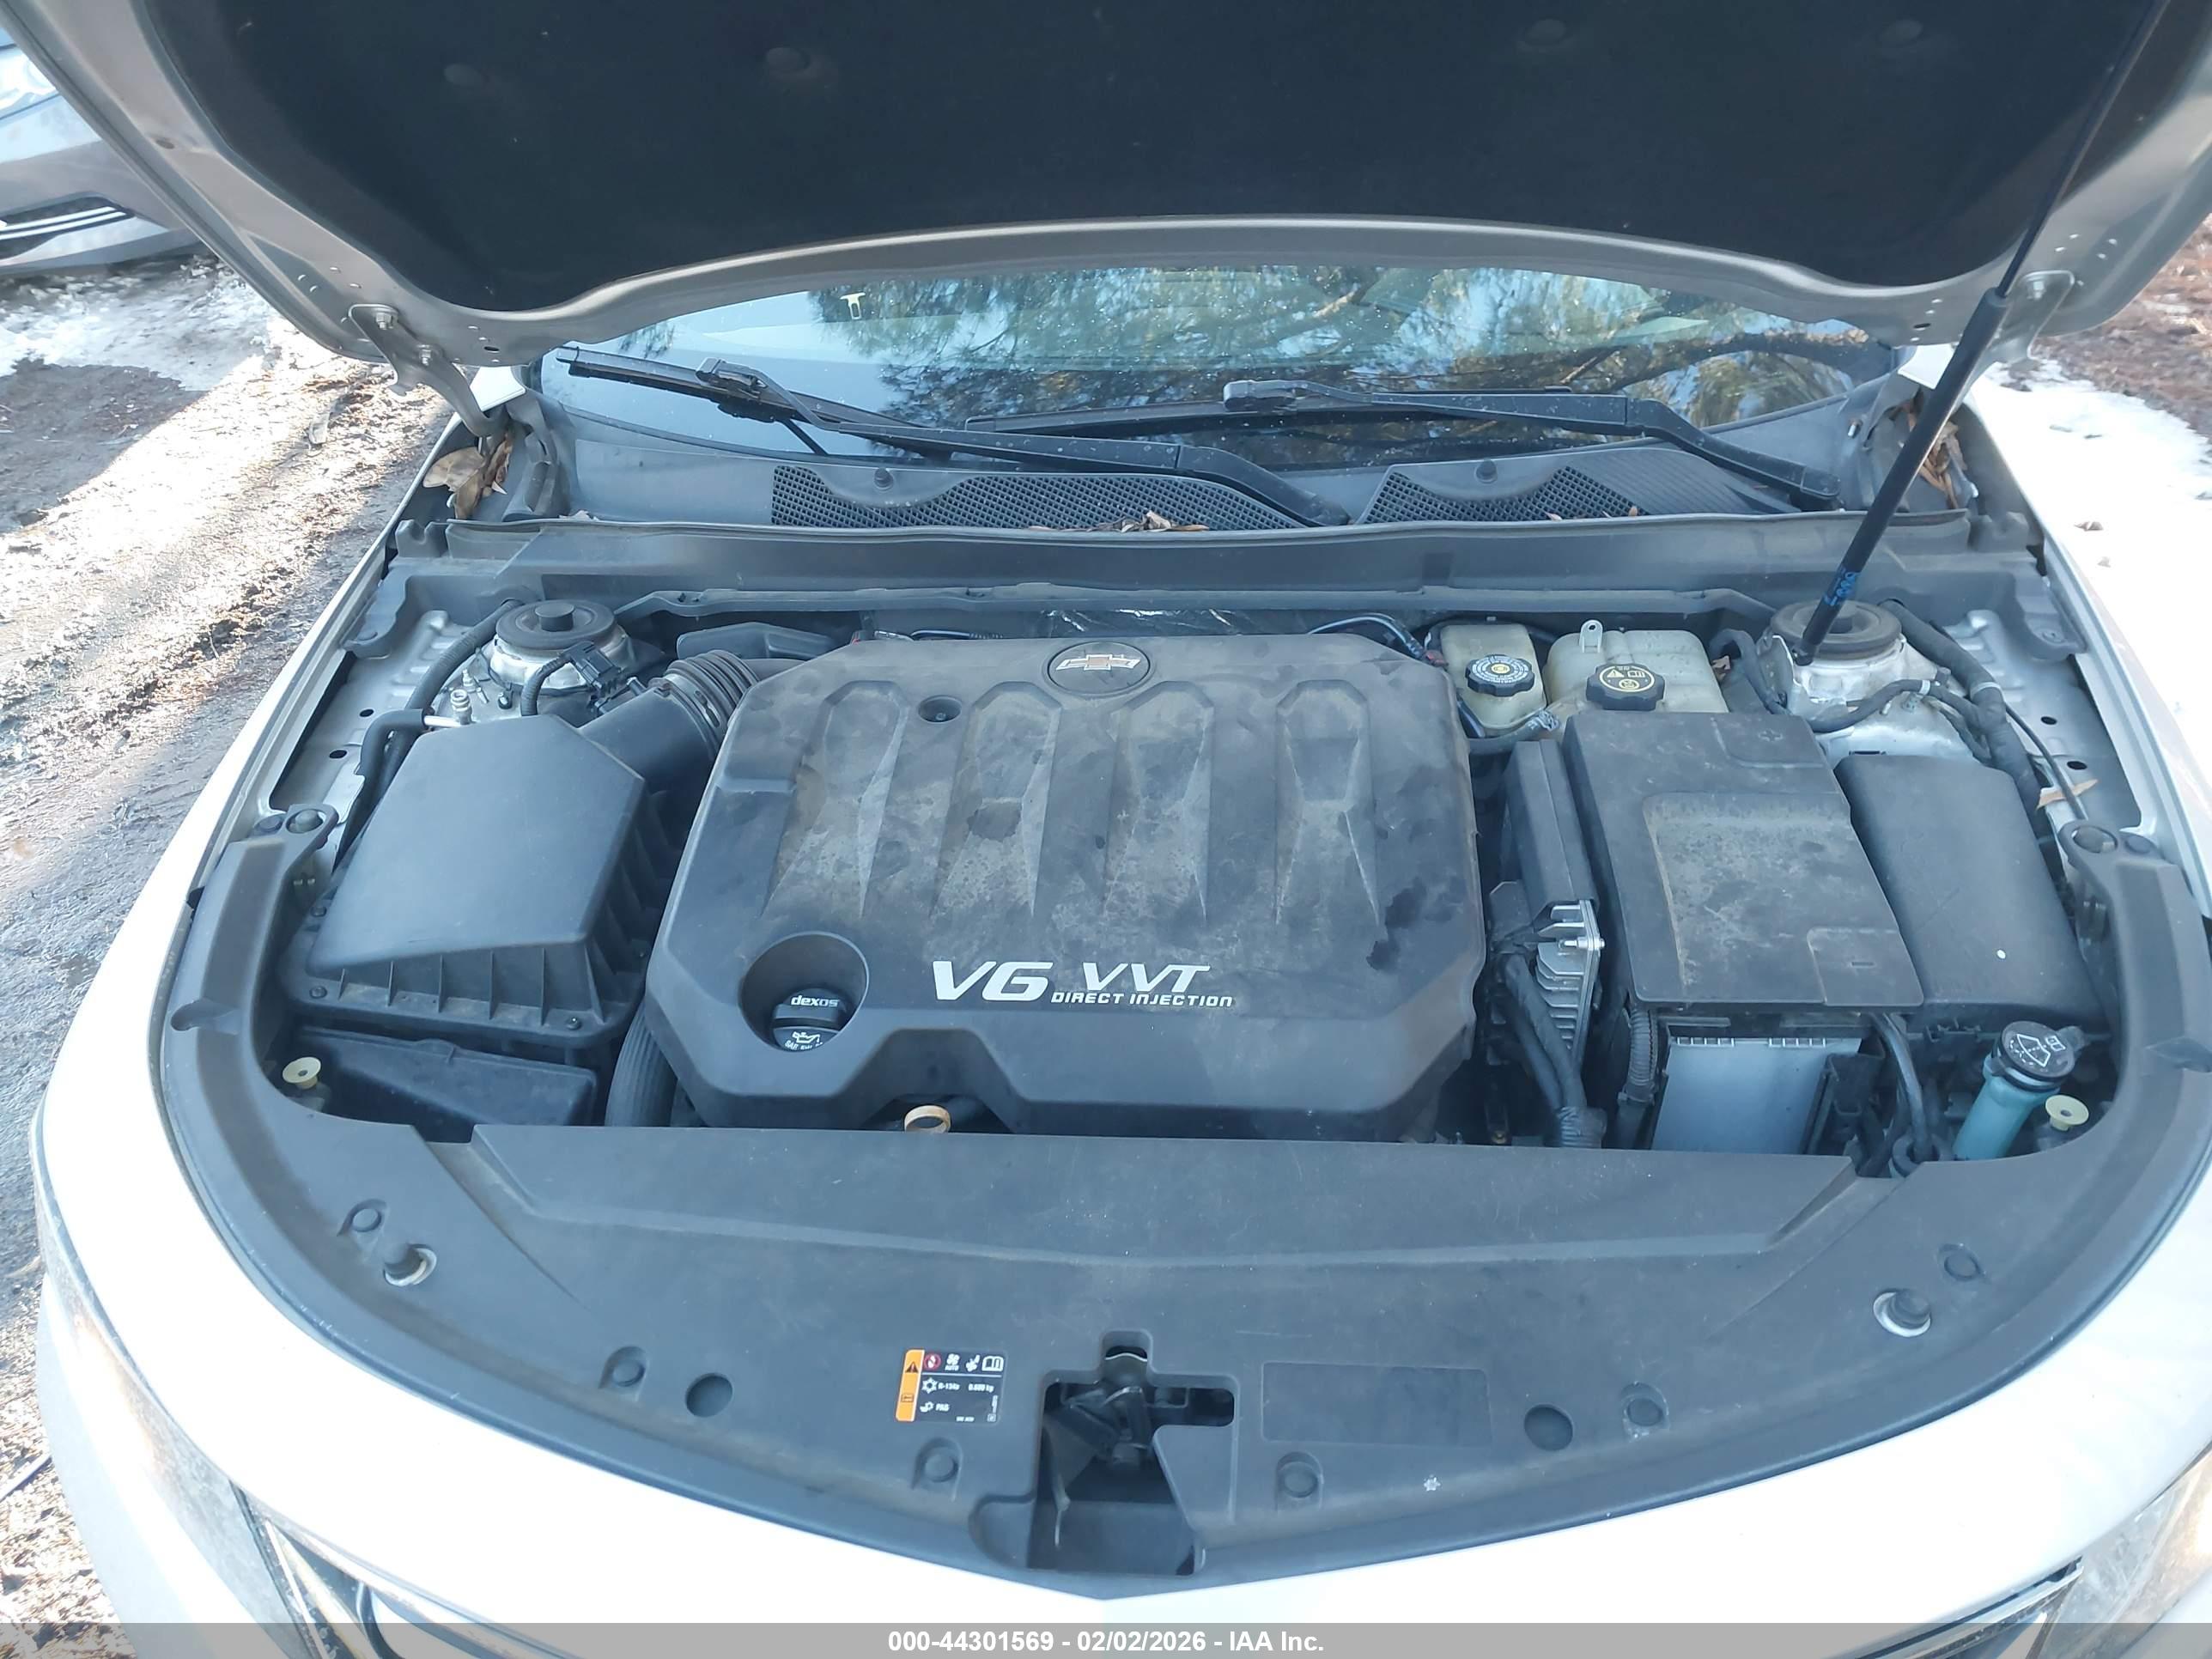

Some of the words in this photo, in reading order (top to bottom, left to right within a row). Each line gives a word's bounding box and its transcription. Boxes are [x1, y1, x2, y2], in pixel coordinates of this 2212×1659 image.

[933, 961, 1054, 1001] V6
[1083, 962, 1210, 993] VVT
[791, 994, 840, 1007] dexos
[1051, 992, 1124, 1005] DIRECT
[1129, 994, 1232, 1007] INJECTION
